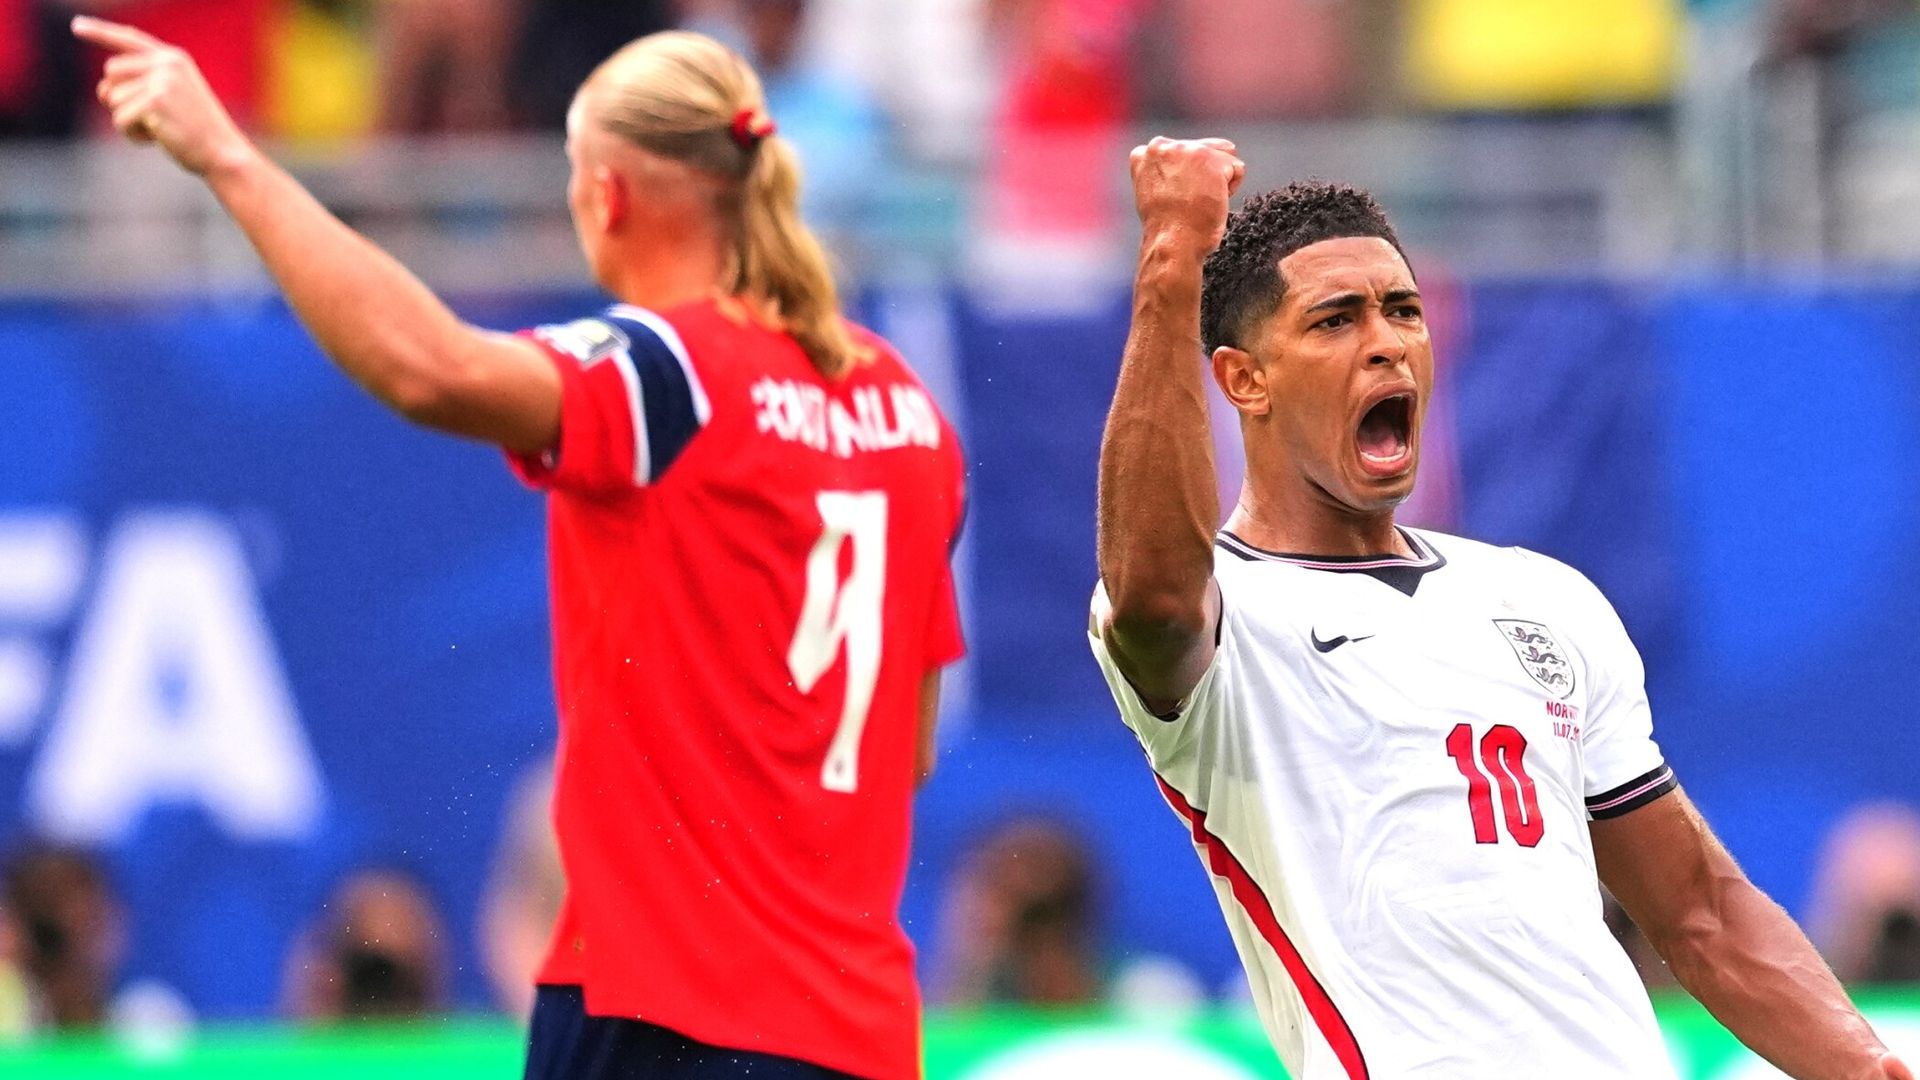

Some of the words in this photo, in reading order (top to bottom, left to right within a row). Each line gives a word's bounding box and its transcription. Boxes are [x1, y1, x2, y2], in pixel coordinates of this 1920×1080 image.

[787, 491, 888, 793] 9
[1546, 701, 1578, 720] NOR
[1446, 724, 1544, 848] 10
